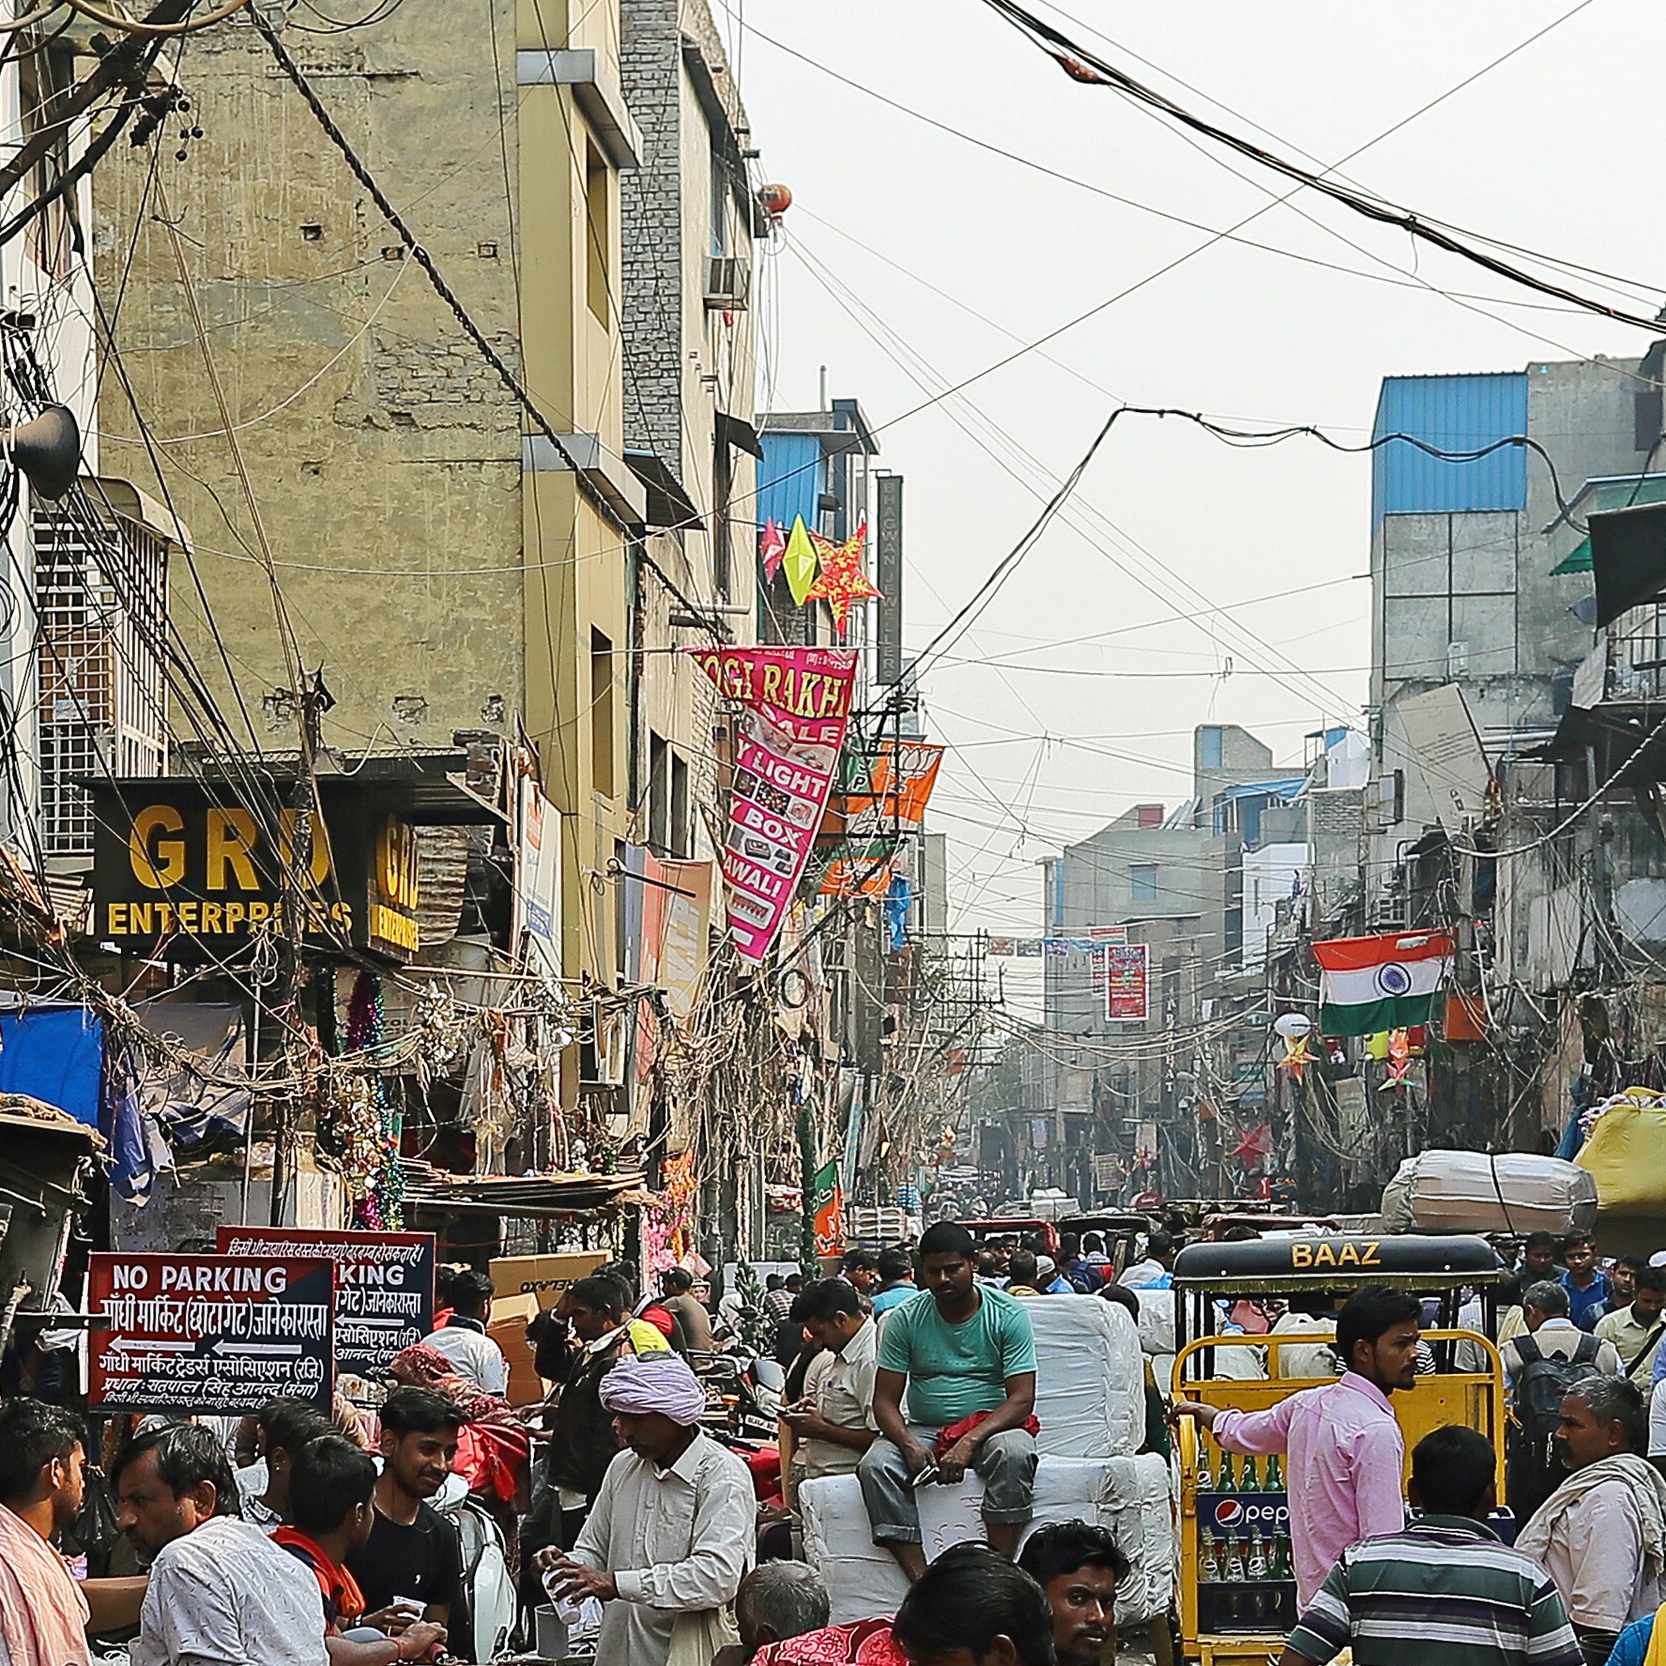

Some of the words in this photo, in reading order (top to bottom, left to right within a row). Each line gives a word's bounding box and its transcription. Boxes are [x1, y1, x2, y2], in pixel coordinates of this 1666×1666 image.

[694, 655, 755, 700] OGI
[752, 752, 827, 799] LIGHT
[744, 807, 805, 849] BOX
[1292, 1241, 1381, 1268] BAAZ
[113, 1265, 148, 1290] NO
[162, 1265, 288, 1293] PARKING
[336, 1264, 405, 1286] KING
